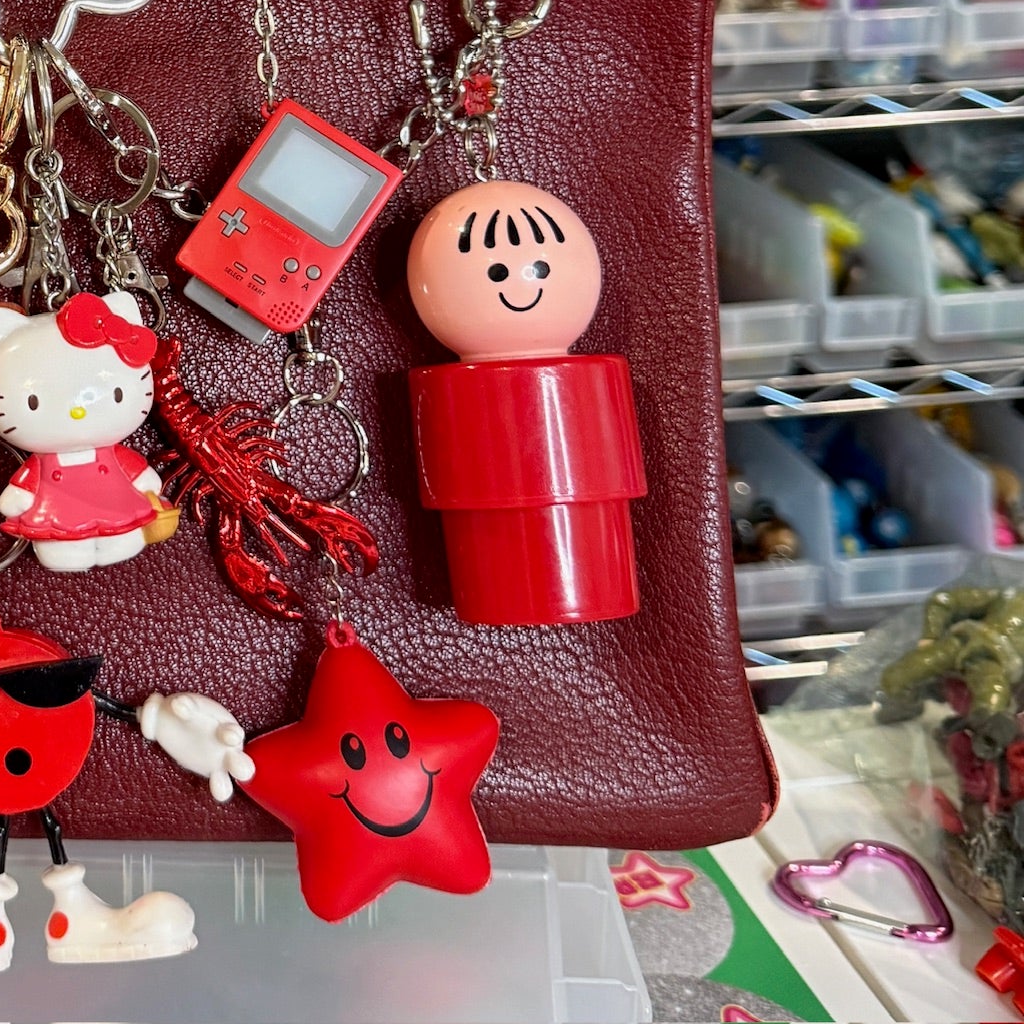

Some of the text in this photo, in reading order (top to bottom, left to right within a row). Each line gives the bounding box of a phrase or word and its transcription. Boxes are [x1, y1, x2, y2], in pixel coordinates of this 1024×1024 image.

[279, 274, 288, 283] B
[247, 282, 266, 297] START
[301, 282, 309, 291] A
